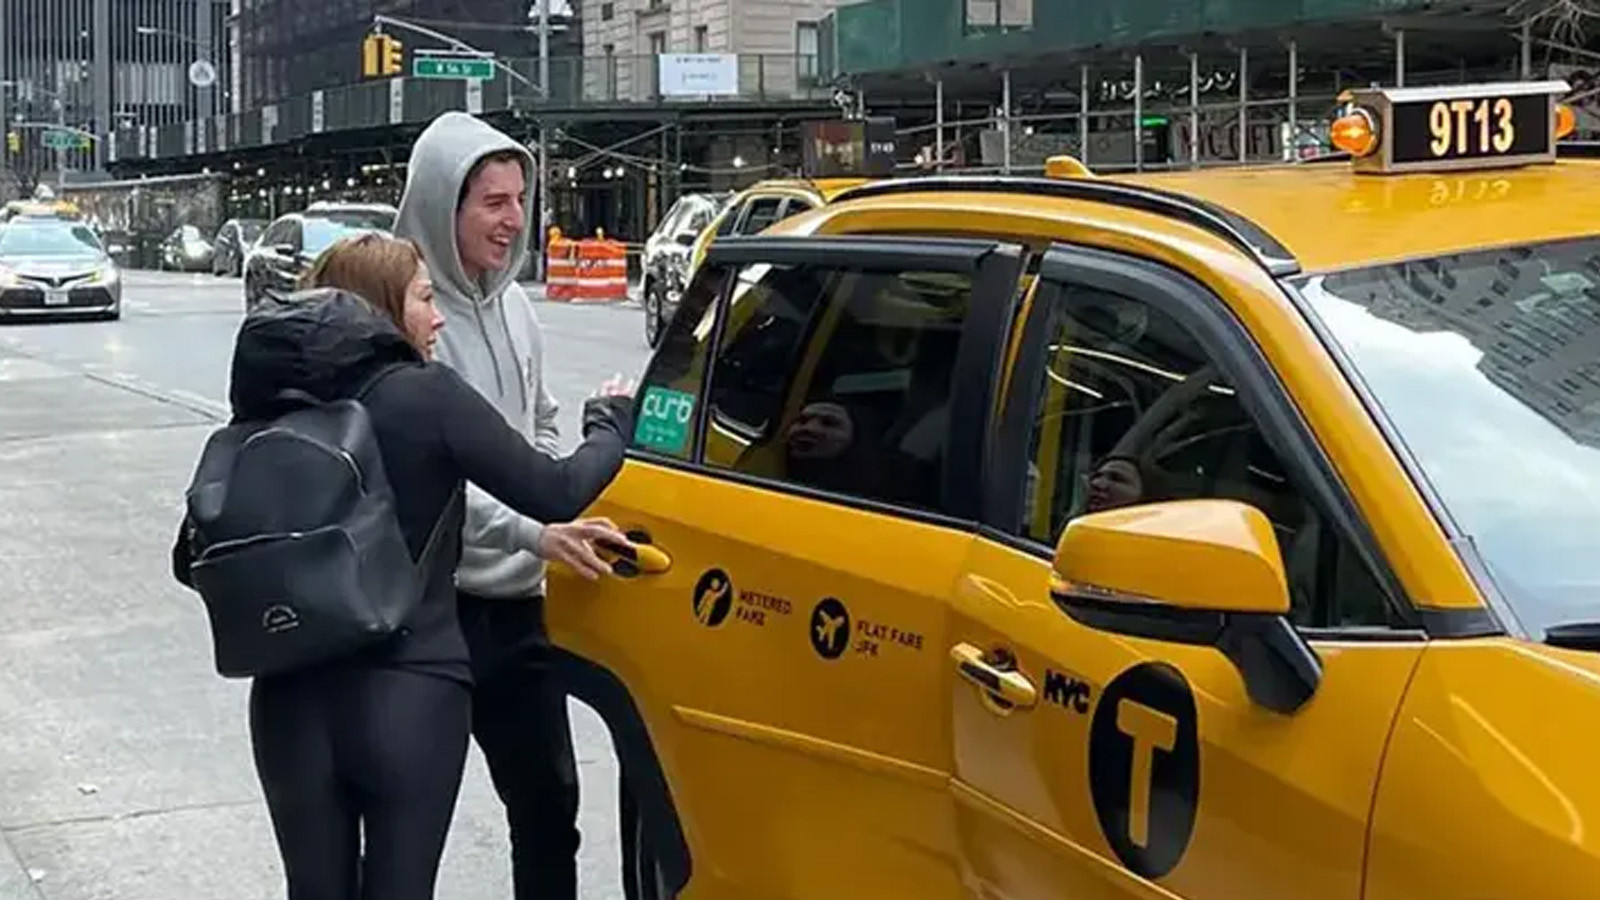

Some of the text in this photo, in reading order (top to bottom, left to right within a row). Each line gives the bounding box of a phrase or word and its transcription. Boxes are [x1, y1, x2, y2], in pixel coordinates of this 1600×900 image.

[1429, 98, 1515, 156] 9T13
[642, 394, 692, 424] curb
[740, 589, 792, 615] METERED
[857, 619, 888, 640] FLAT
[1043, 668, 1091, 715] NYC
[1116, 697, 1178, 849] T
